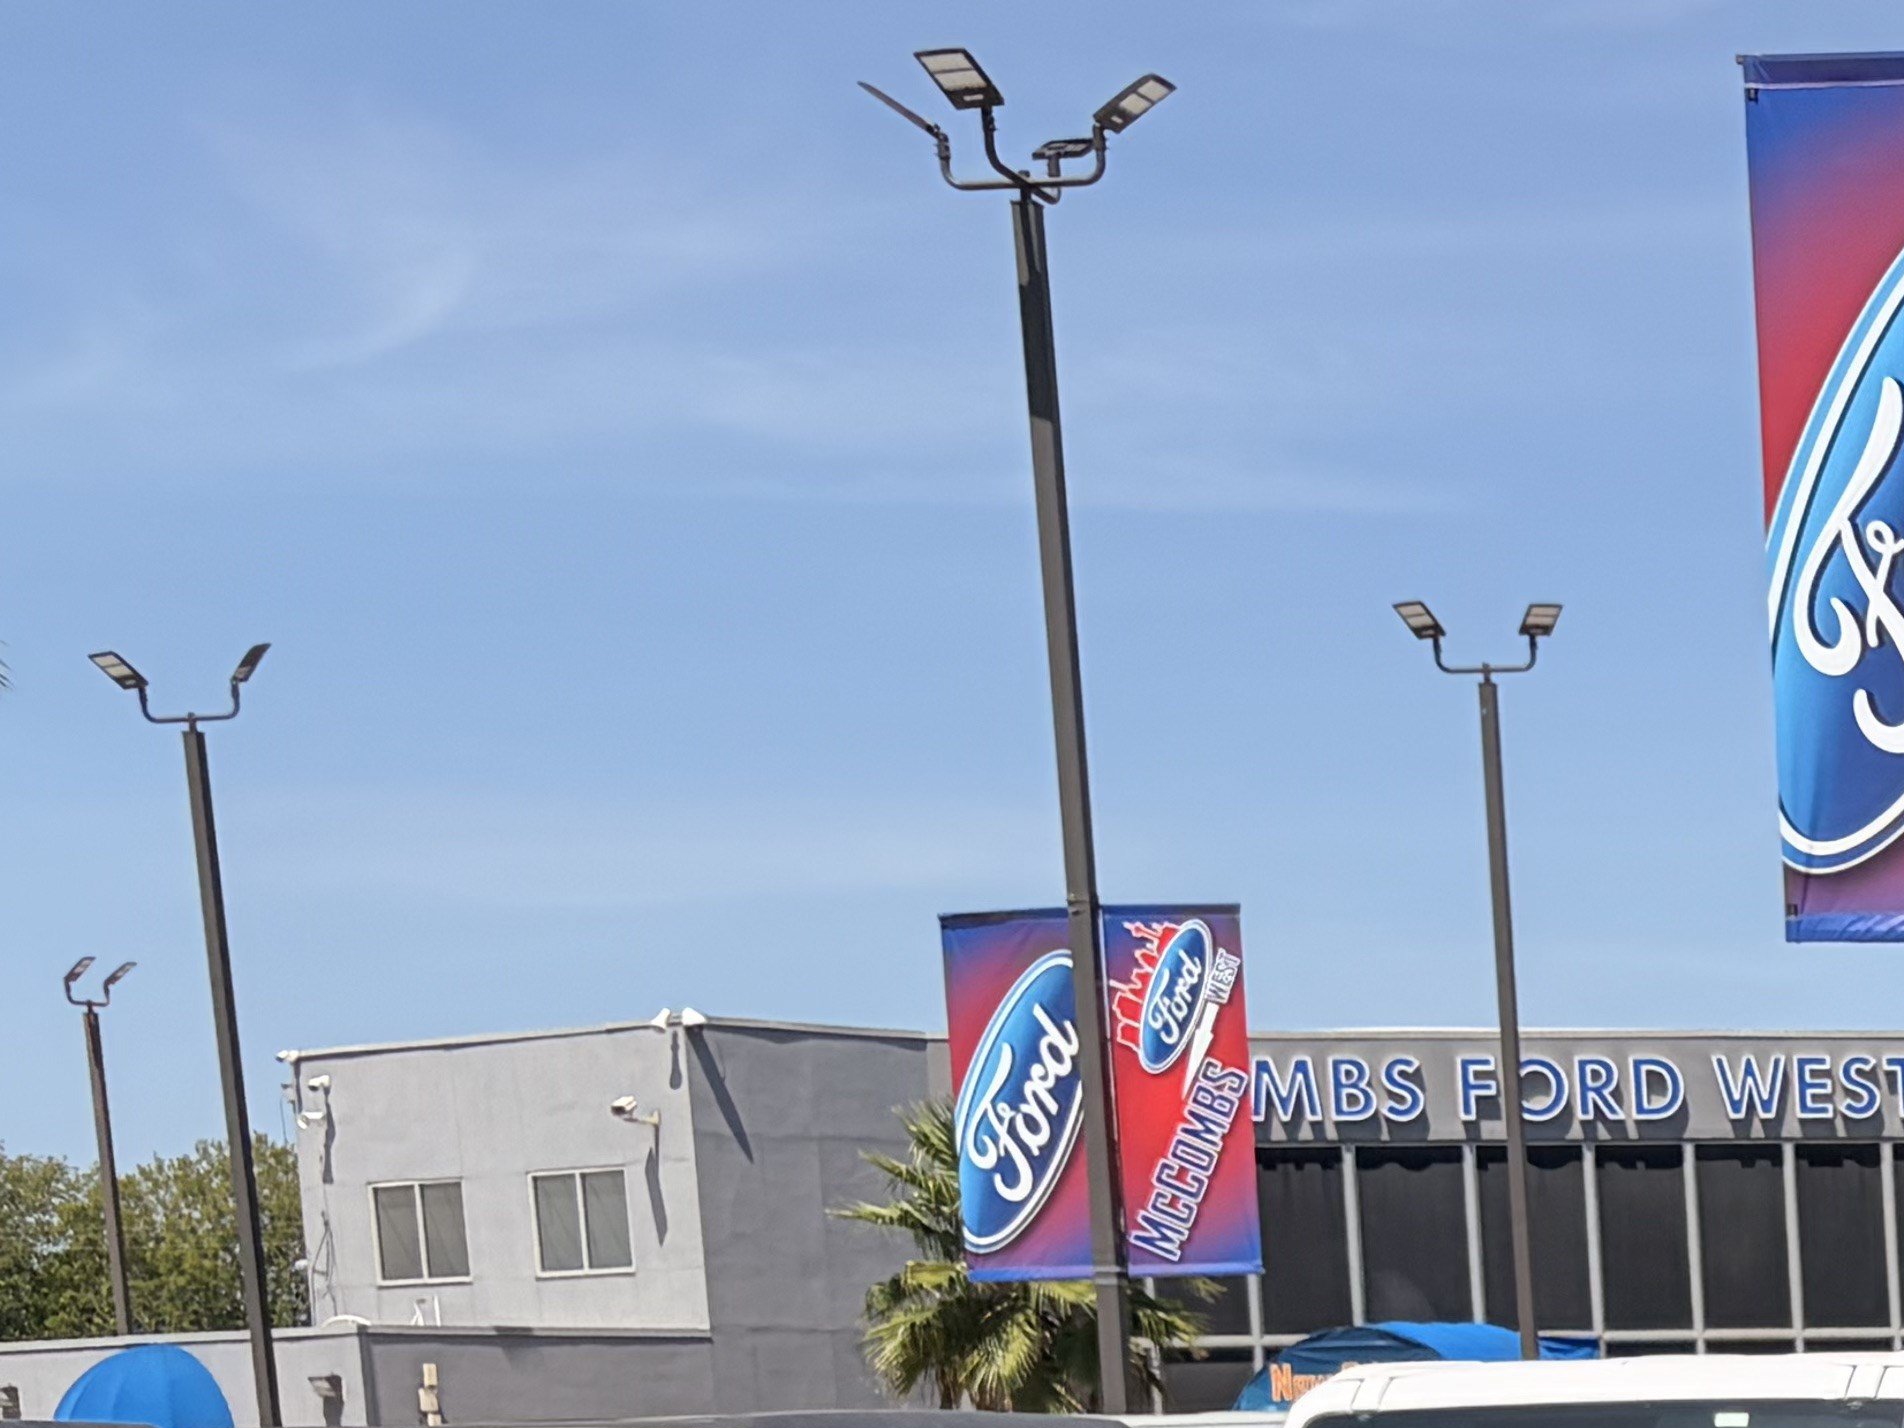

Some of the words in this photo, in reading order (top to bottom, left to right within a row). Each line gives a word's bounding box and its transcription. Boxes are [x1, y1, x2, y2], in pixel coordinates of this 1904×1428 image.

[1147, 949, 1202, 1045] Ford
[1204, 948, 1242, 1004] WEST
[966, 1003, 1080, 1203] Ford
[1457, 1053, 1686, 1123] FORD
